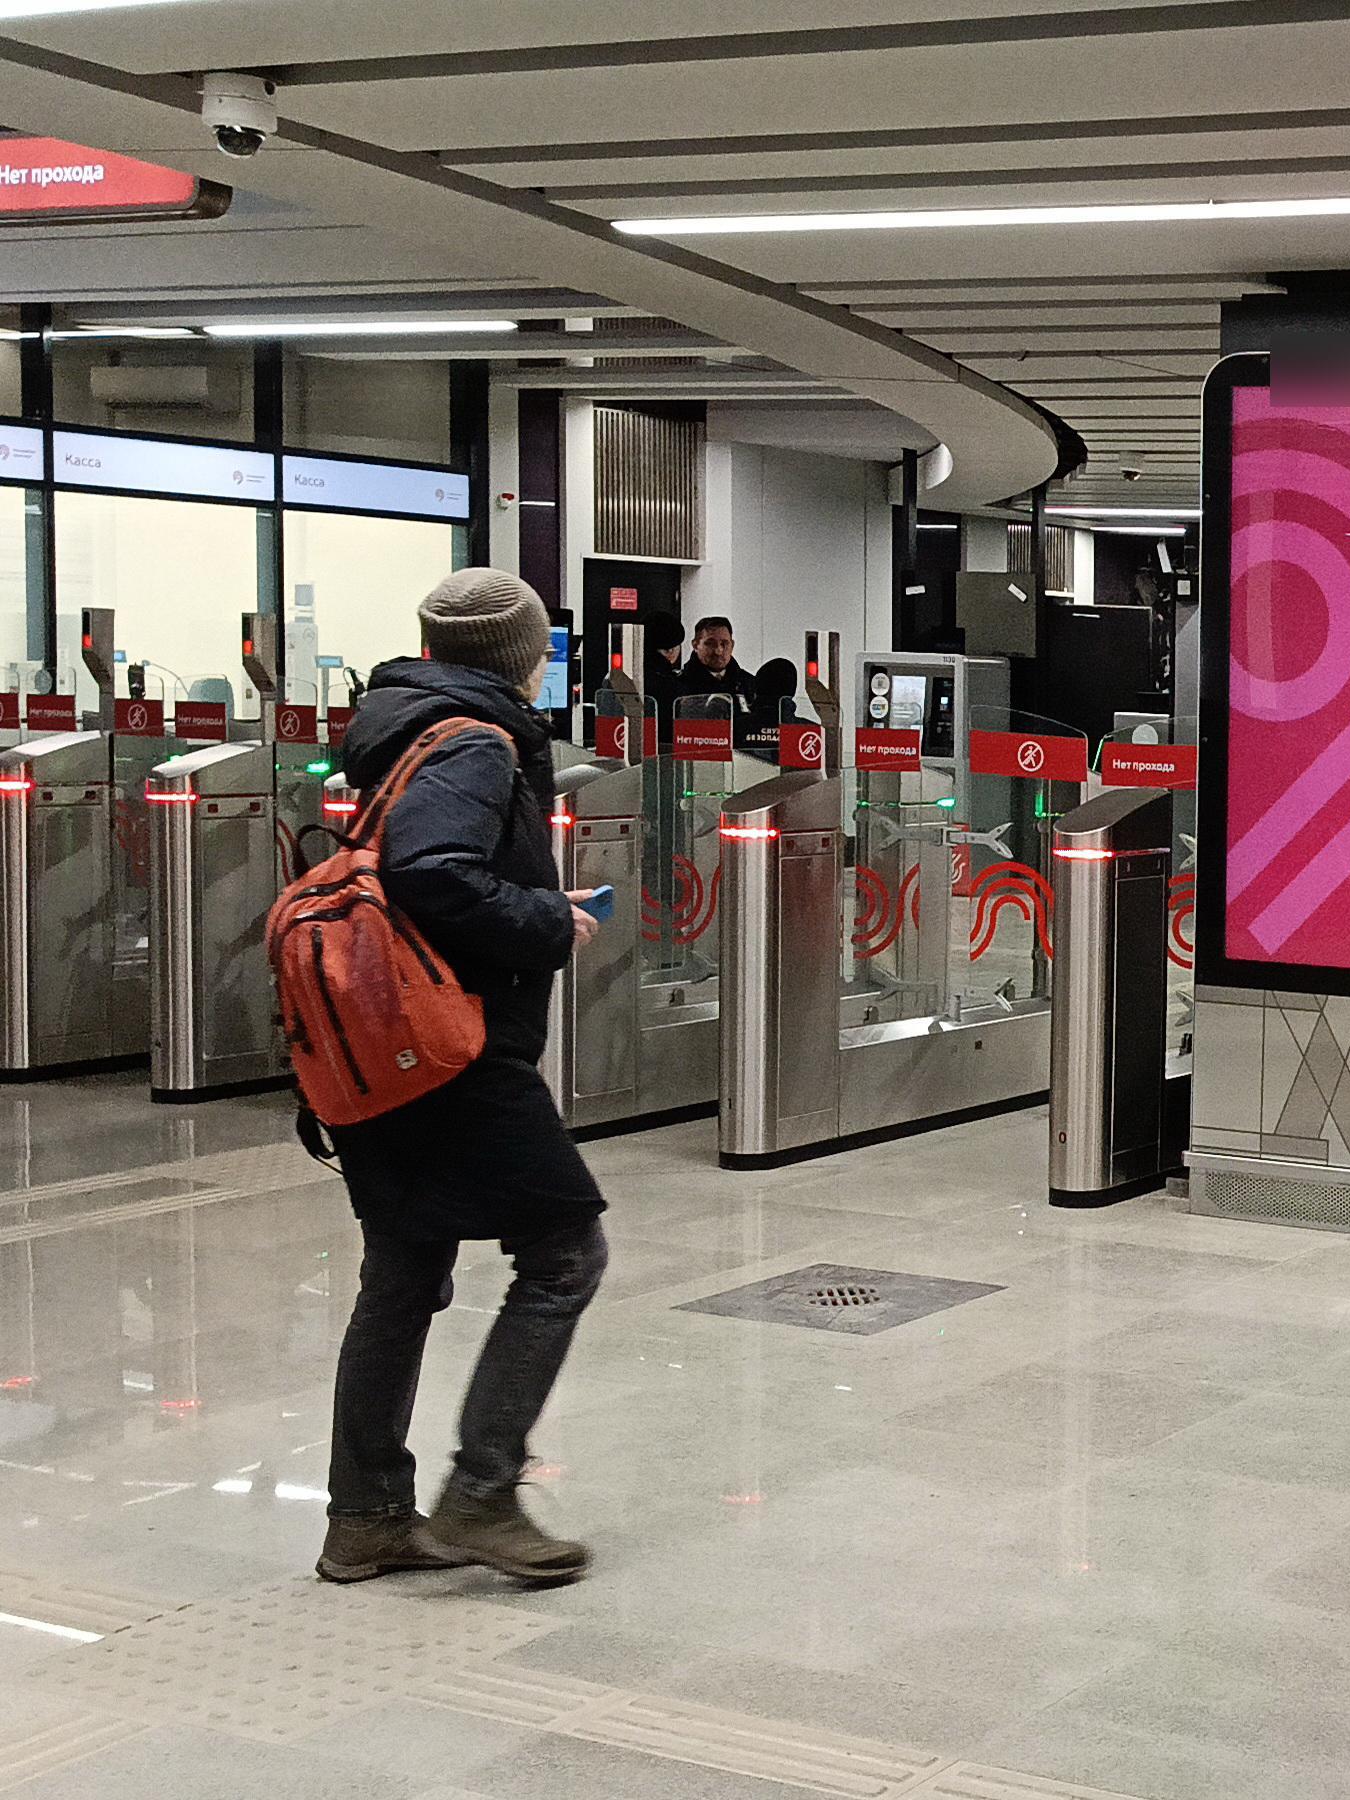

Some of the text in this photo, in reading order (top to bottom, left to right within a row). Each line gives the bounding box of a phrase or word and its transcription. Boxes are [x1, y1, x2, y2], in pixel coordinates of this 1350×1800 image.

[0, 164, 105, 188] Нет прохода
[64, 453, 102, 469] Касса
[294, 474, 325, 488] Касса
[676, 736, 729, 746] Нет прохода
[859, 744, 917, 756] Нет прохода
[1112, 758, 1175, 773] Нет прохода
